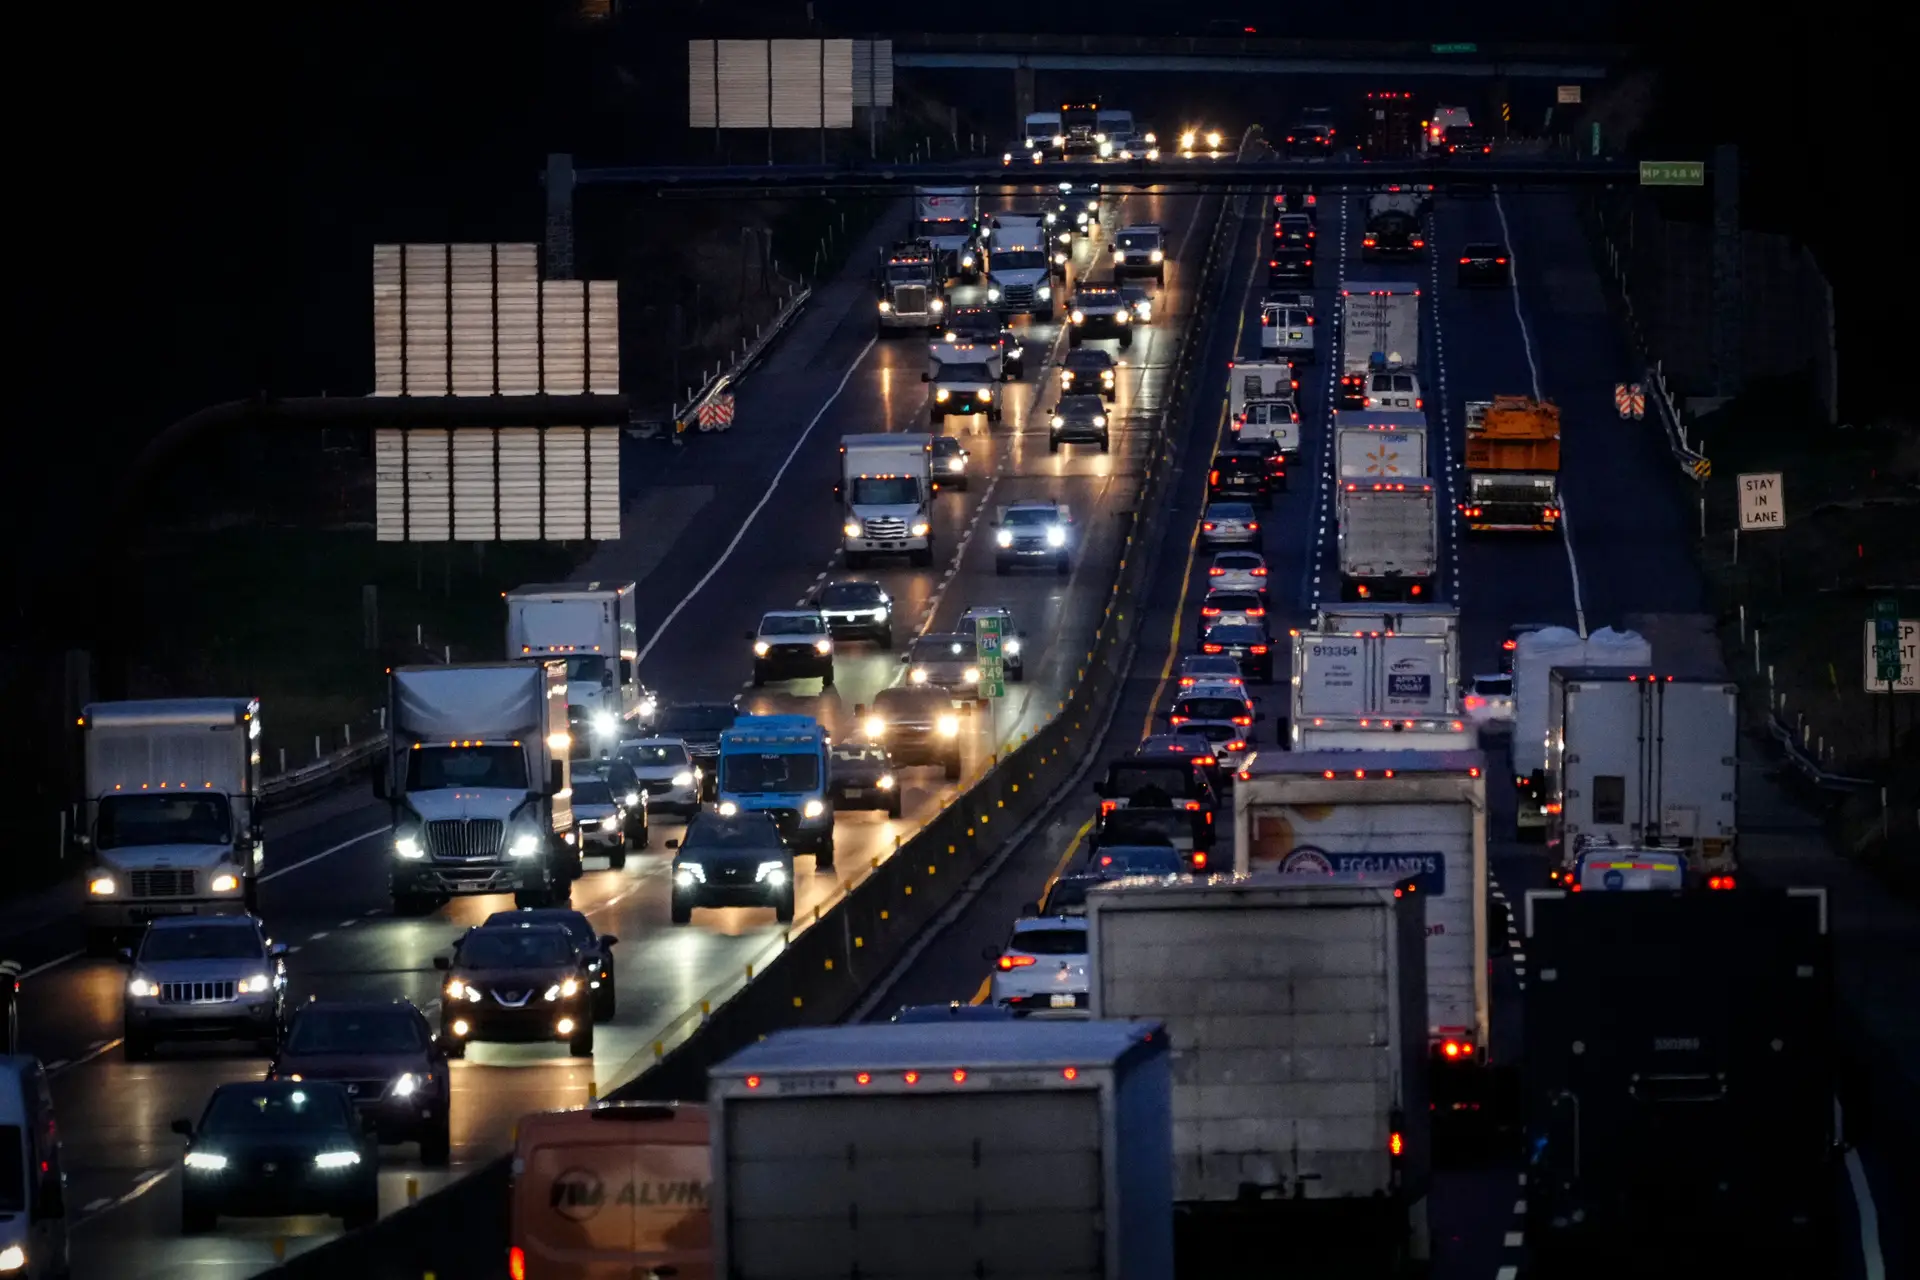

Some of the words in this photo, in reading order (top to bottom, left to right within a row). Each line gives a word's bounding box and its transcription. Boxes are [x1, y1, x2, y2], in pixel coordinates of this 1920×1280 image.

[1642, 168, 1660, 178] MP
[1690, 168, 1701, 178] W
[1746, 479, 1775, 491] STAY
[1755, 495, 1767, 506] IN
[1746, 511, 1778, 523] LANE
[983, 638, 997, 649] 276
[1313, 646, 1358, 657] 913354
[980, 656, 1001, 666] MILE
[979, 667, 1002, 680] 349
[1393, 684, 1425, 692] TODAY
